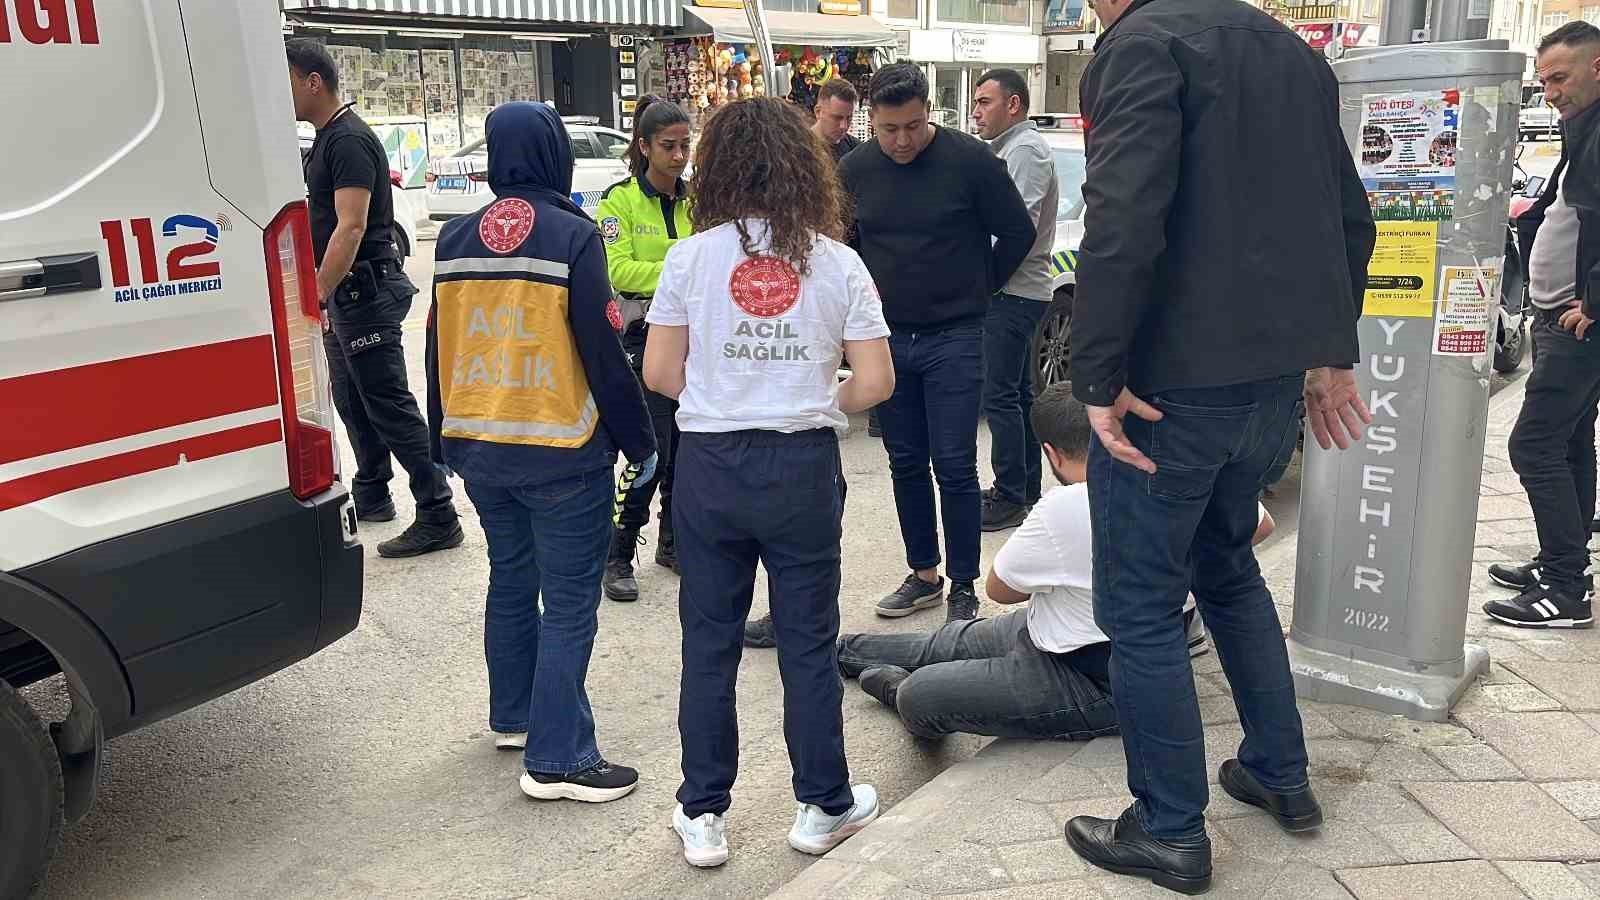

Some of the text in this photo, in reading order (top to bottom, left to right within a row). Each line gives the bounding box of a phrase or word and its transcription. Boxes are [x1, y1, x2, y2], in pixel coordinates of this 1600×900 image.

[100, 214, 221, 288] 112
[115, 277, 222, 303] ACİL ÇAĞRI MERKEZİ
[734, 319, 799, 339] ACİL
[723, 339, 810, 362] SAĞLIK
[1344, 607, 1390, 633] 2022
